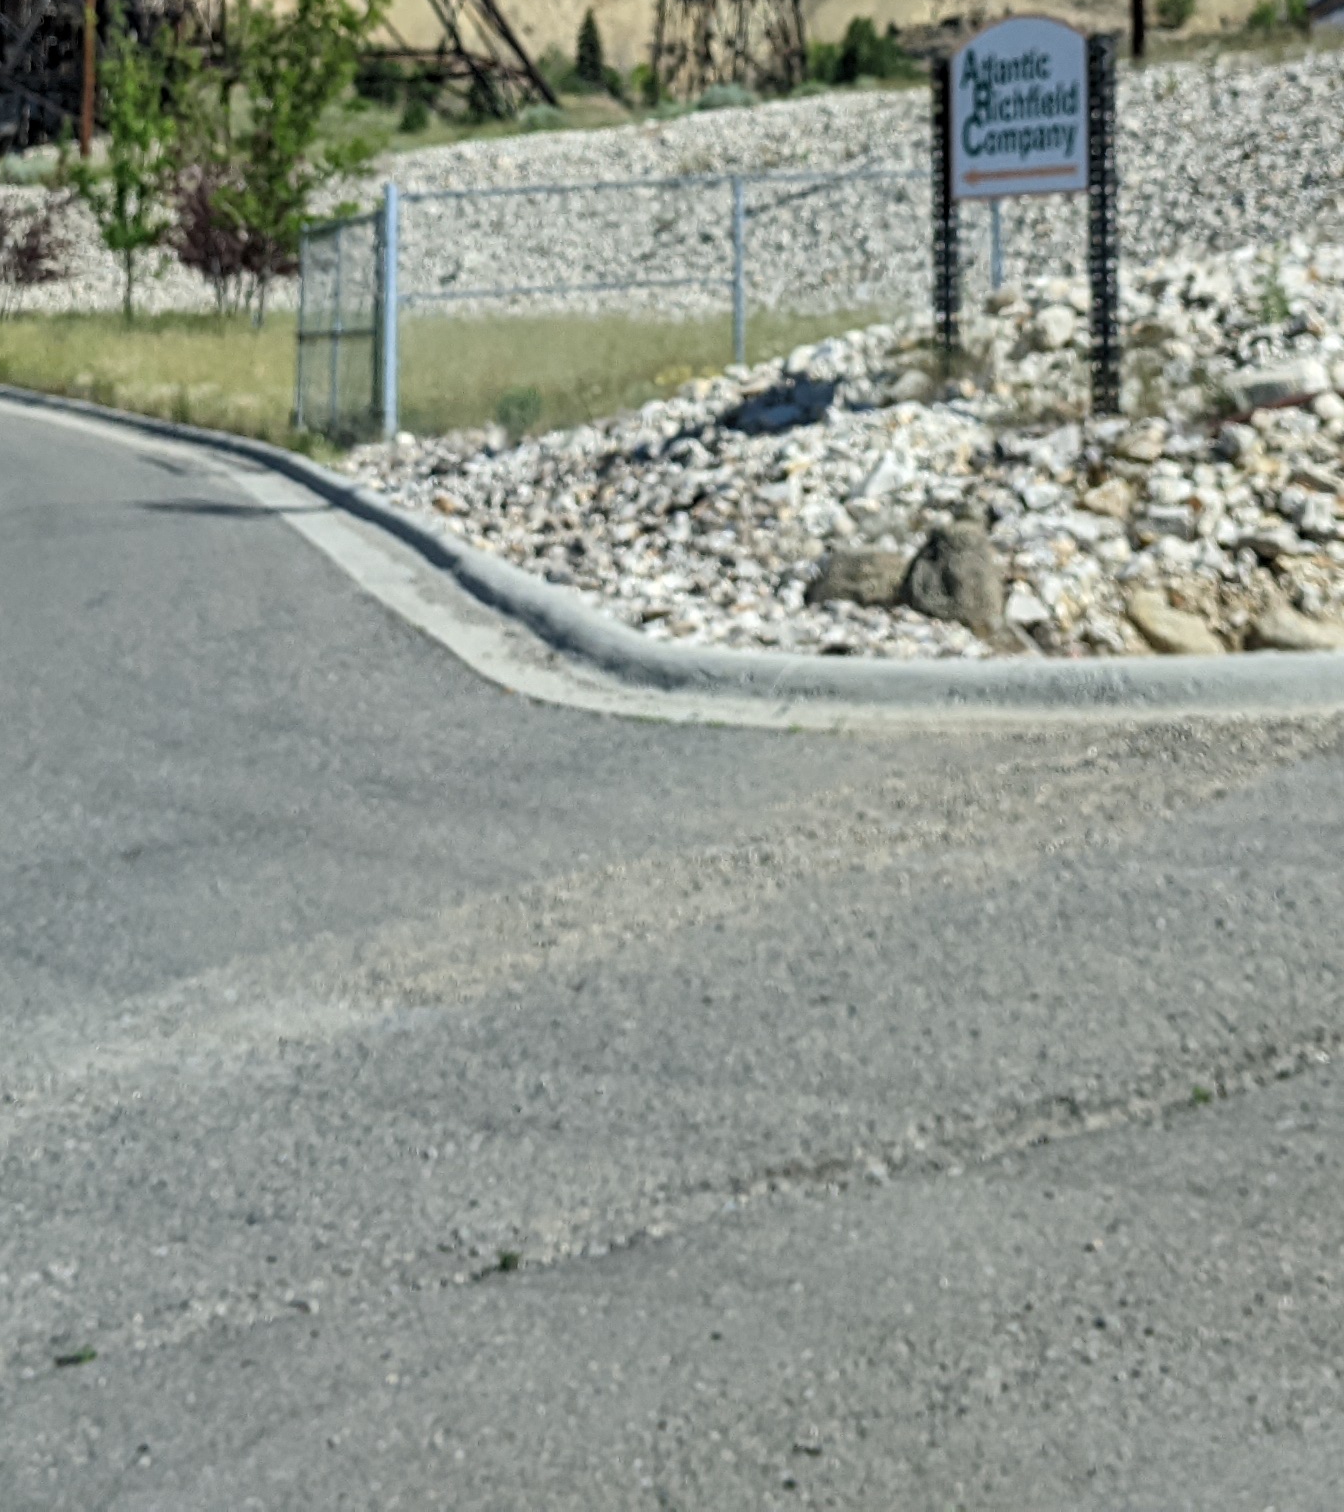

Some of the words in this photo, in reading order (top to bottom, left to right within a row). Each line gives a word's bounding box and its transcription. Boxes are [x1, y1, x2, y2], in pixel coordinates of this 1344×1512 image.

[959, 48, 1051, 89] Atlantic
[972, 79, 1080, 122] Richfield
[962, 113, 1077, 159] Company
